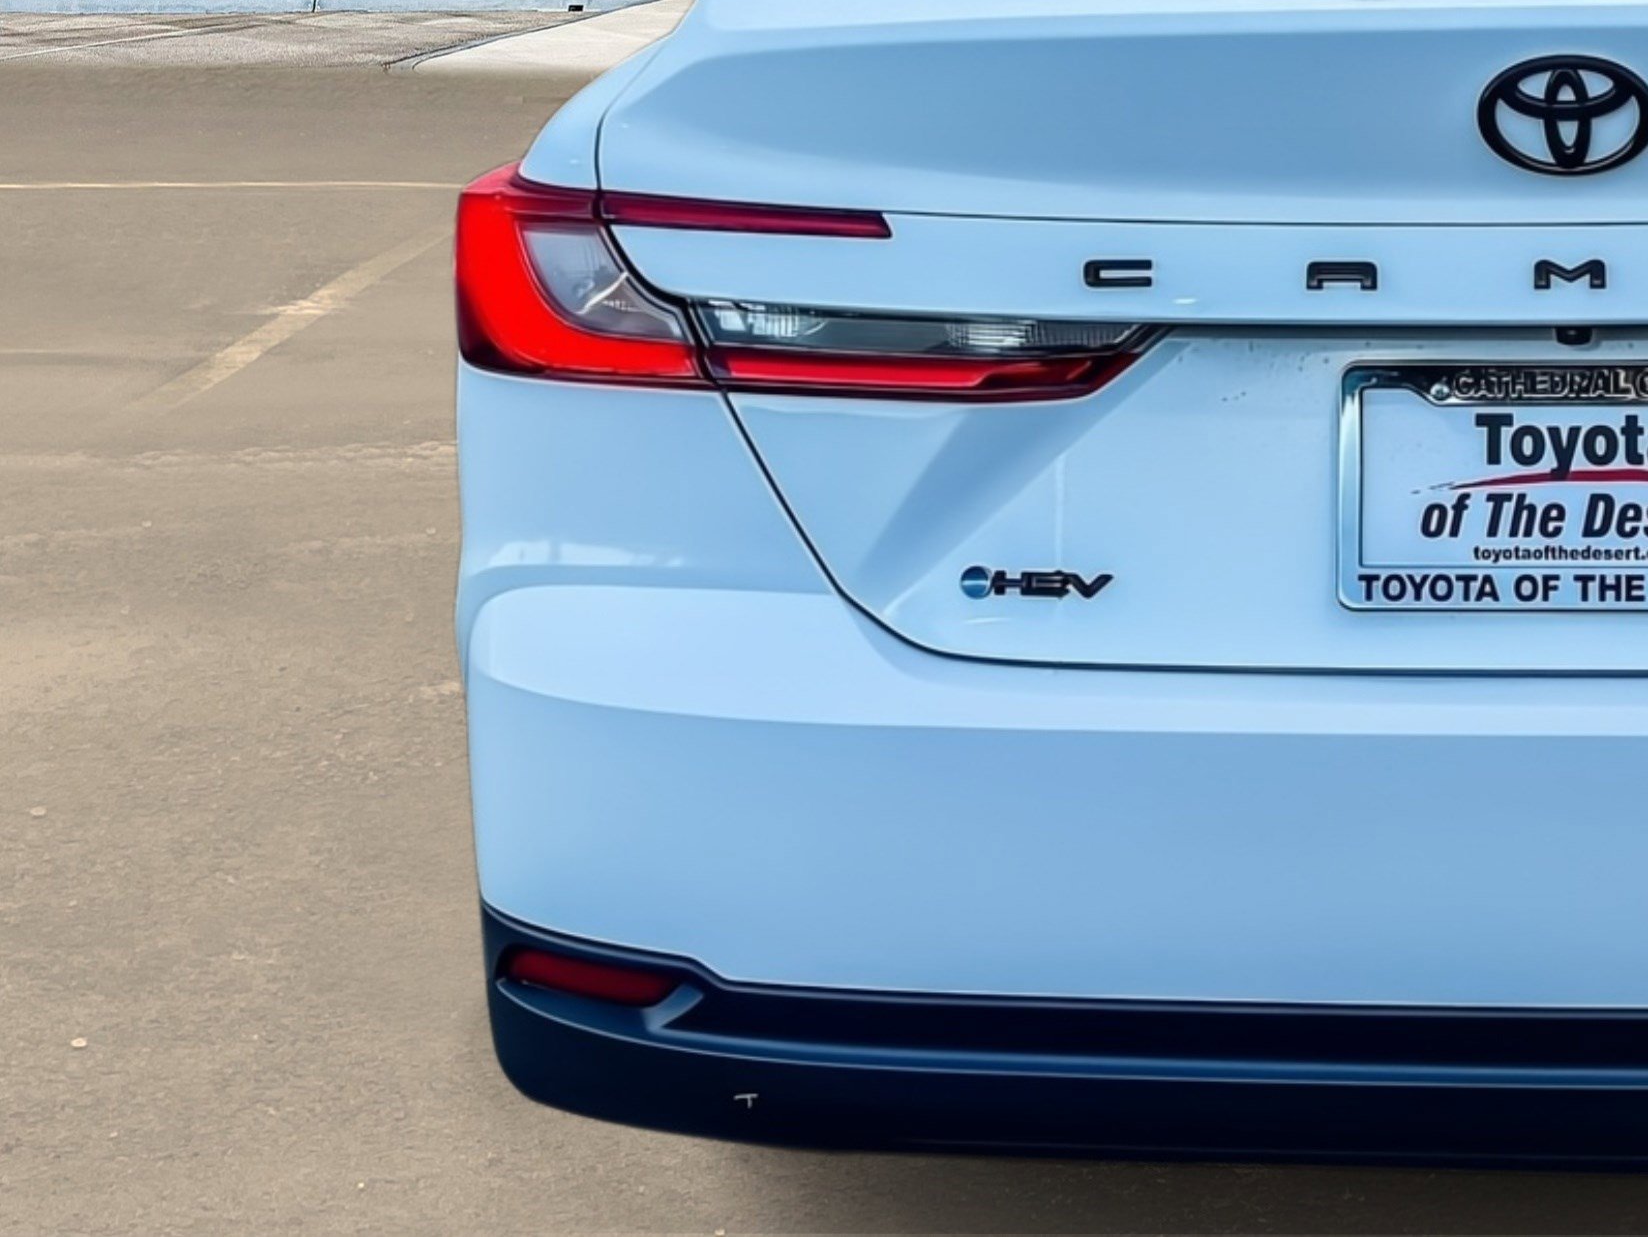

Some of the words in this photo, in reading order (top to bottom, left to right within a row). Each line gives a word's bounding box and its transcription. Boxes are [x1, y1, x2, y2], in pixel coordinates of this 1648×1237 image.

[1453, 369, 1634, 398] CATHEDRAL
[1420, 493, 1471, 539] of
[1485, 493, 1567, 539] The
[993, 570, 1114, 600] HEV
[1358, 574, 1500, 603] TOYOTA
[1513, 574, 1562, 603] OF
[1573, 574, 1646, 603] THE
